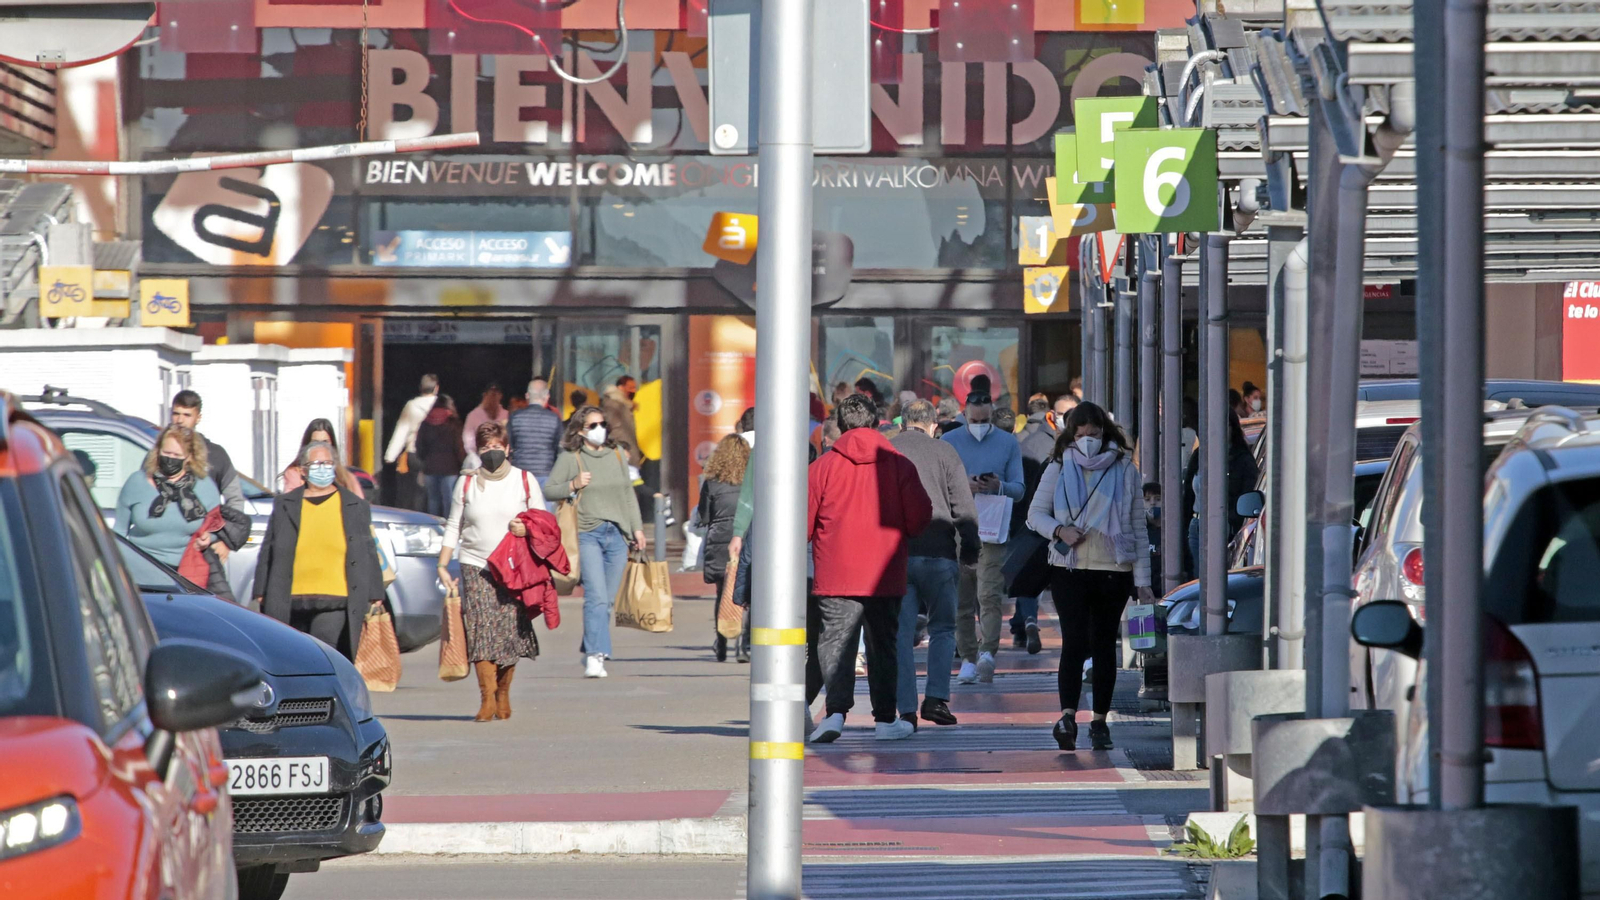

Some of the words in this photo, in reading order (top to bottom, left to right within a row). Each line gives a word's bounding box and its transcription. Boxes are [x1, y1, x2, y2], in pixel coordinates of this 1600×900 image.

[366, 49, 1144, 145] BIENVNID
[365, 160, 520, 185] BIENVENUE
[525, 161, 677, 187] WELCOME
[1143, 146, 1191, 218] 6
[416, 238, 466, 251] ACCESO
[478, 238, 528, 251] ACCESO
[1035, 225, 1048, 258] 1
[1564, 281, 1579, 298] El
[1568, 304, 1584, 319] te
[1584, 304, 1599, 319] lo
[231, 763, 282, 790] 2866
[288, 762, 323, 788] FSJ
